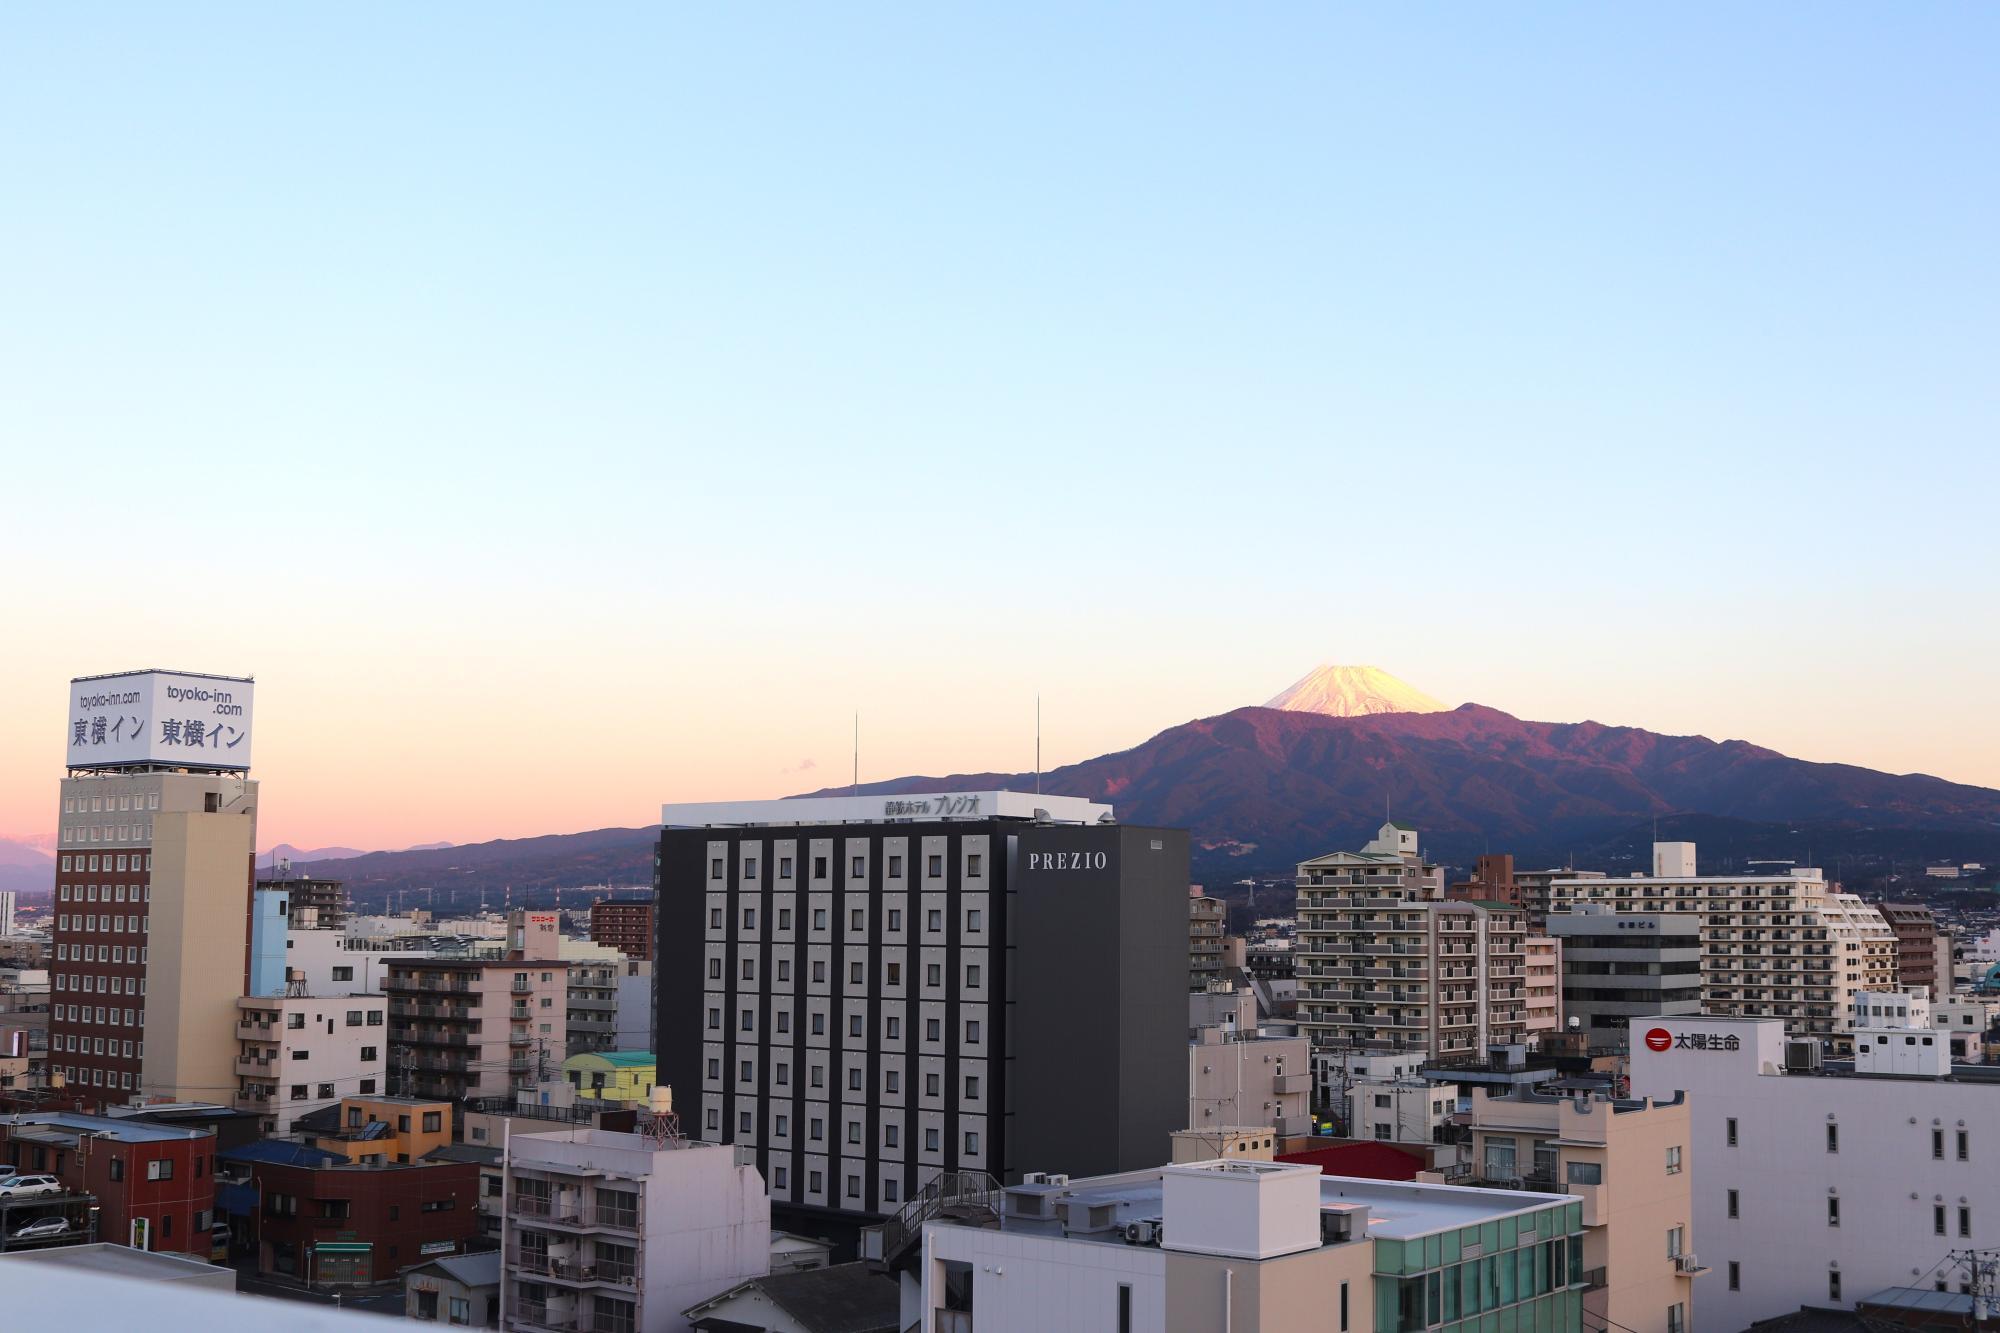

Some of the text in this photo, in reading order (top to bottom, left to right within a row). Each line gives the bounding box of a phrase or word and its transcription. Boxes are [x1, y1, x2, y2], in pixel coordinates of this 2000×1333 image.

[80, 690, 141, 711] toyoko-inn.com
[167, 685, 232, 704] toyoko-inn
[212, 702, 242, 716] .com
[73, 715, 145, 747] 東横イン
[160, 718, 245, 749] 東横イン
[1029, 851, 1107, 870] PREZIO
[1674, 1032, 1741, 1052] 太陽生命
